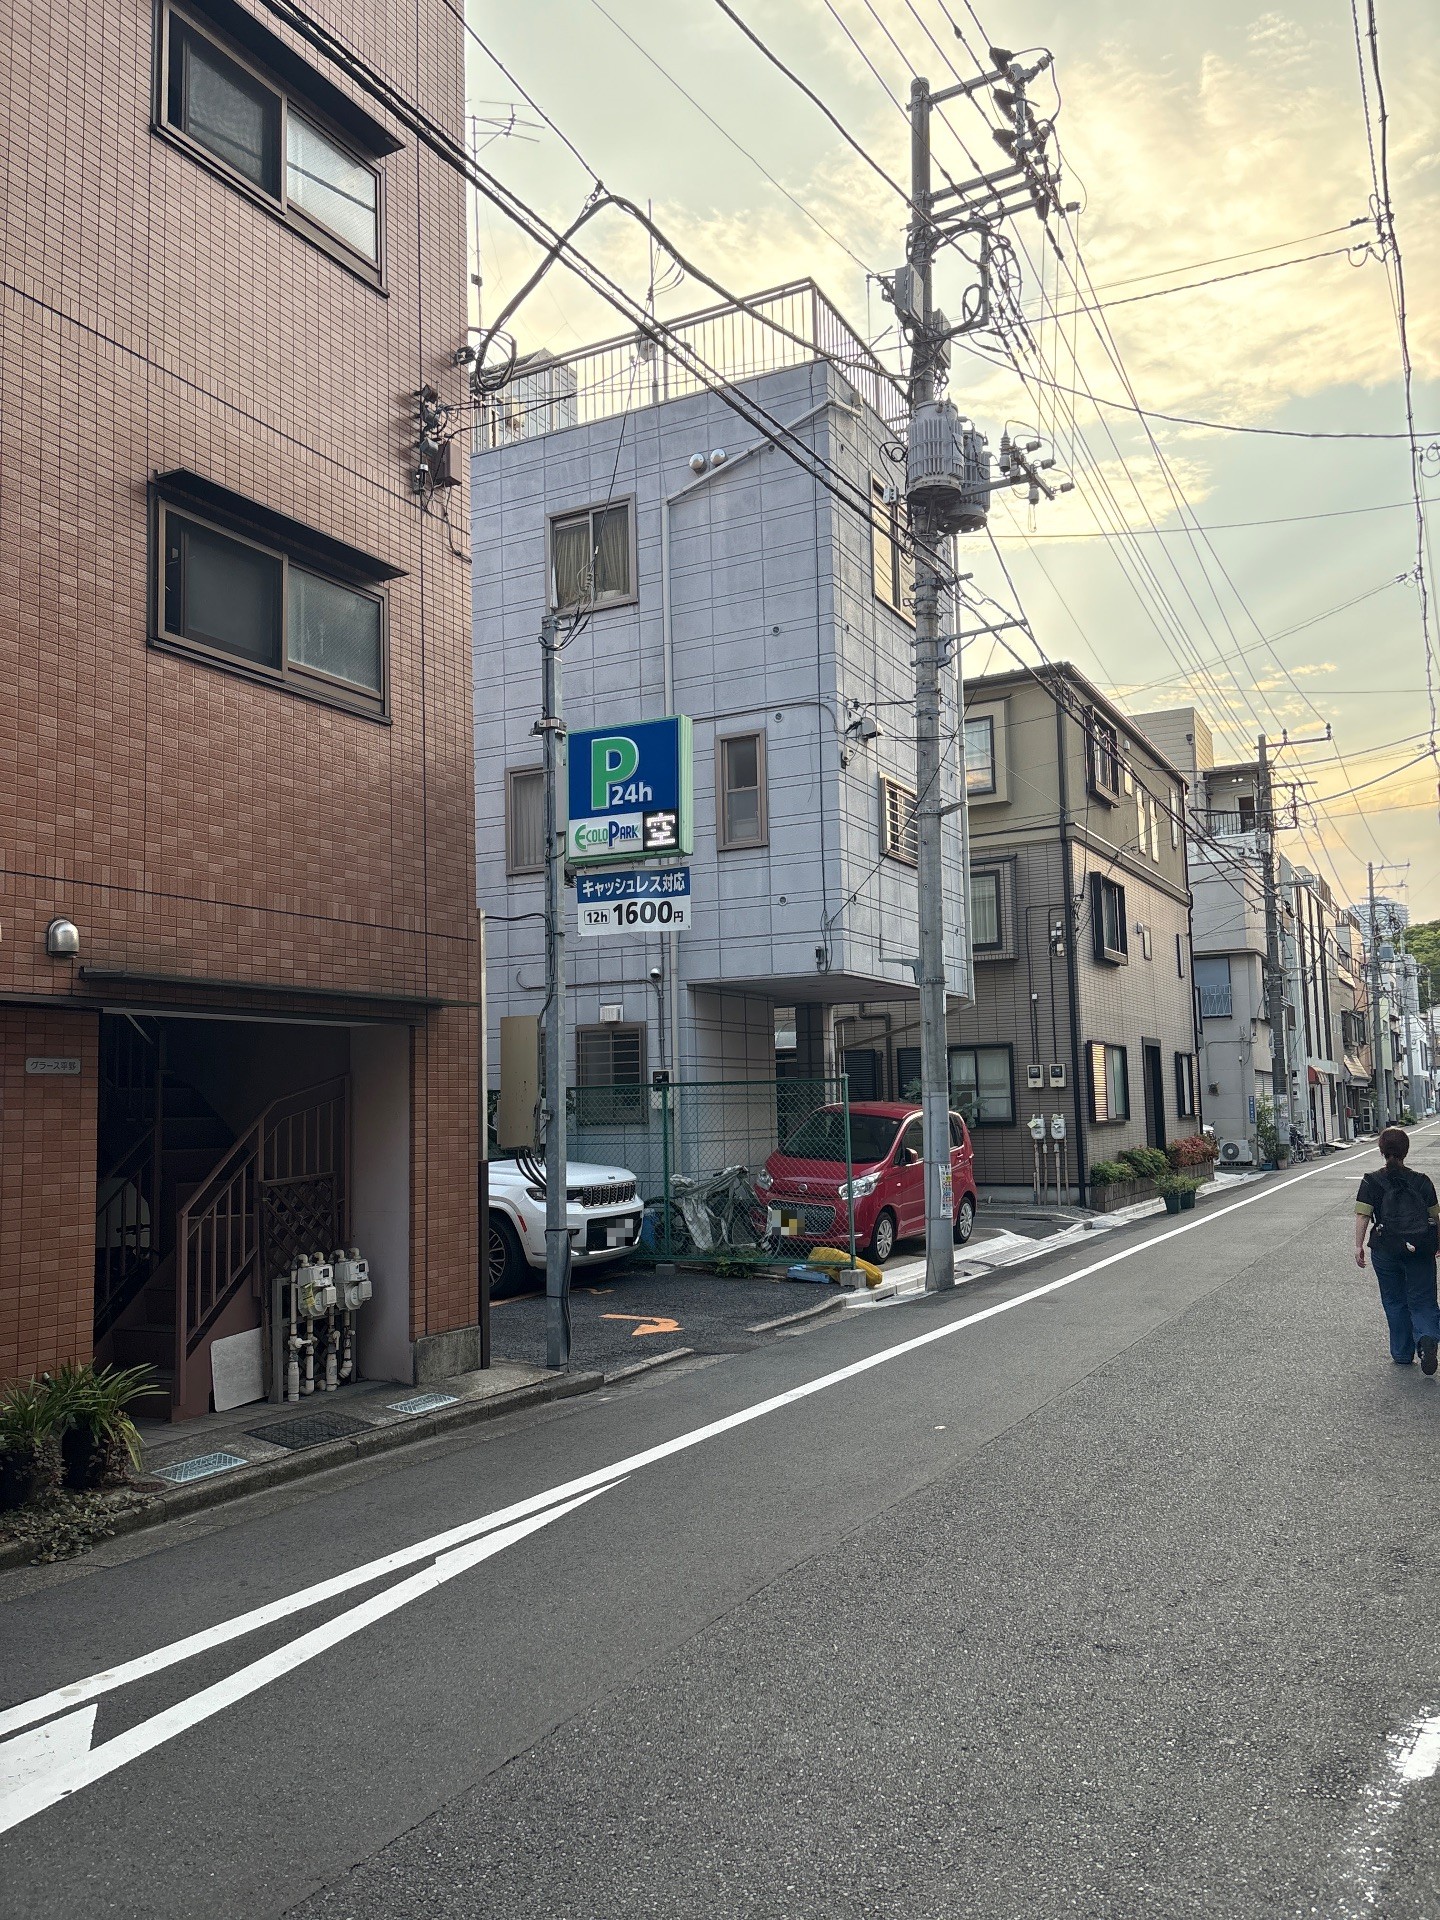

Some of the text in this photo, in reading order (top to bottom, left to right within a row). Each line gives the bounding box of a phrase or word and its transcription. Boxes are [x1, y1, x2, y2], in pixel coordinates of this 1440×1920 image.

[590, 736, 640, 811] P
[611, 781, 653, 806] 24h
[646, 812, 676, 847] 空
[582, 872, 686, 898] キャッシュレス対応
[587, 911, 608, 924] 12h
